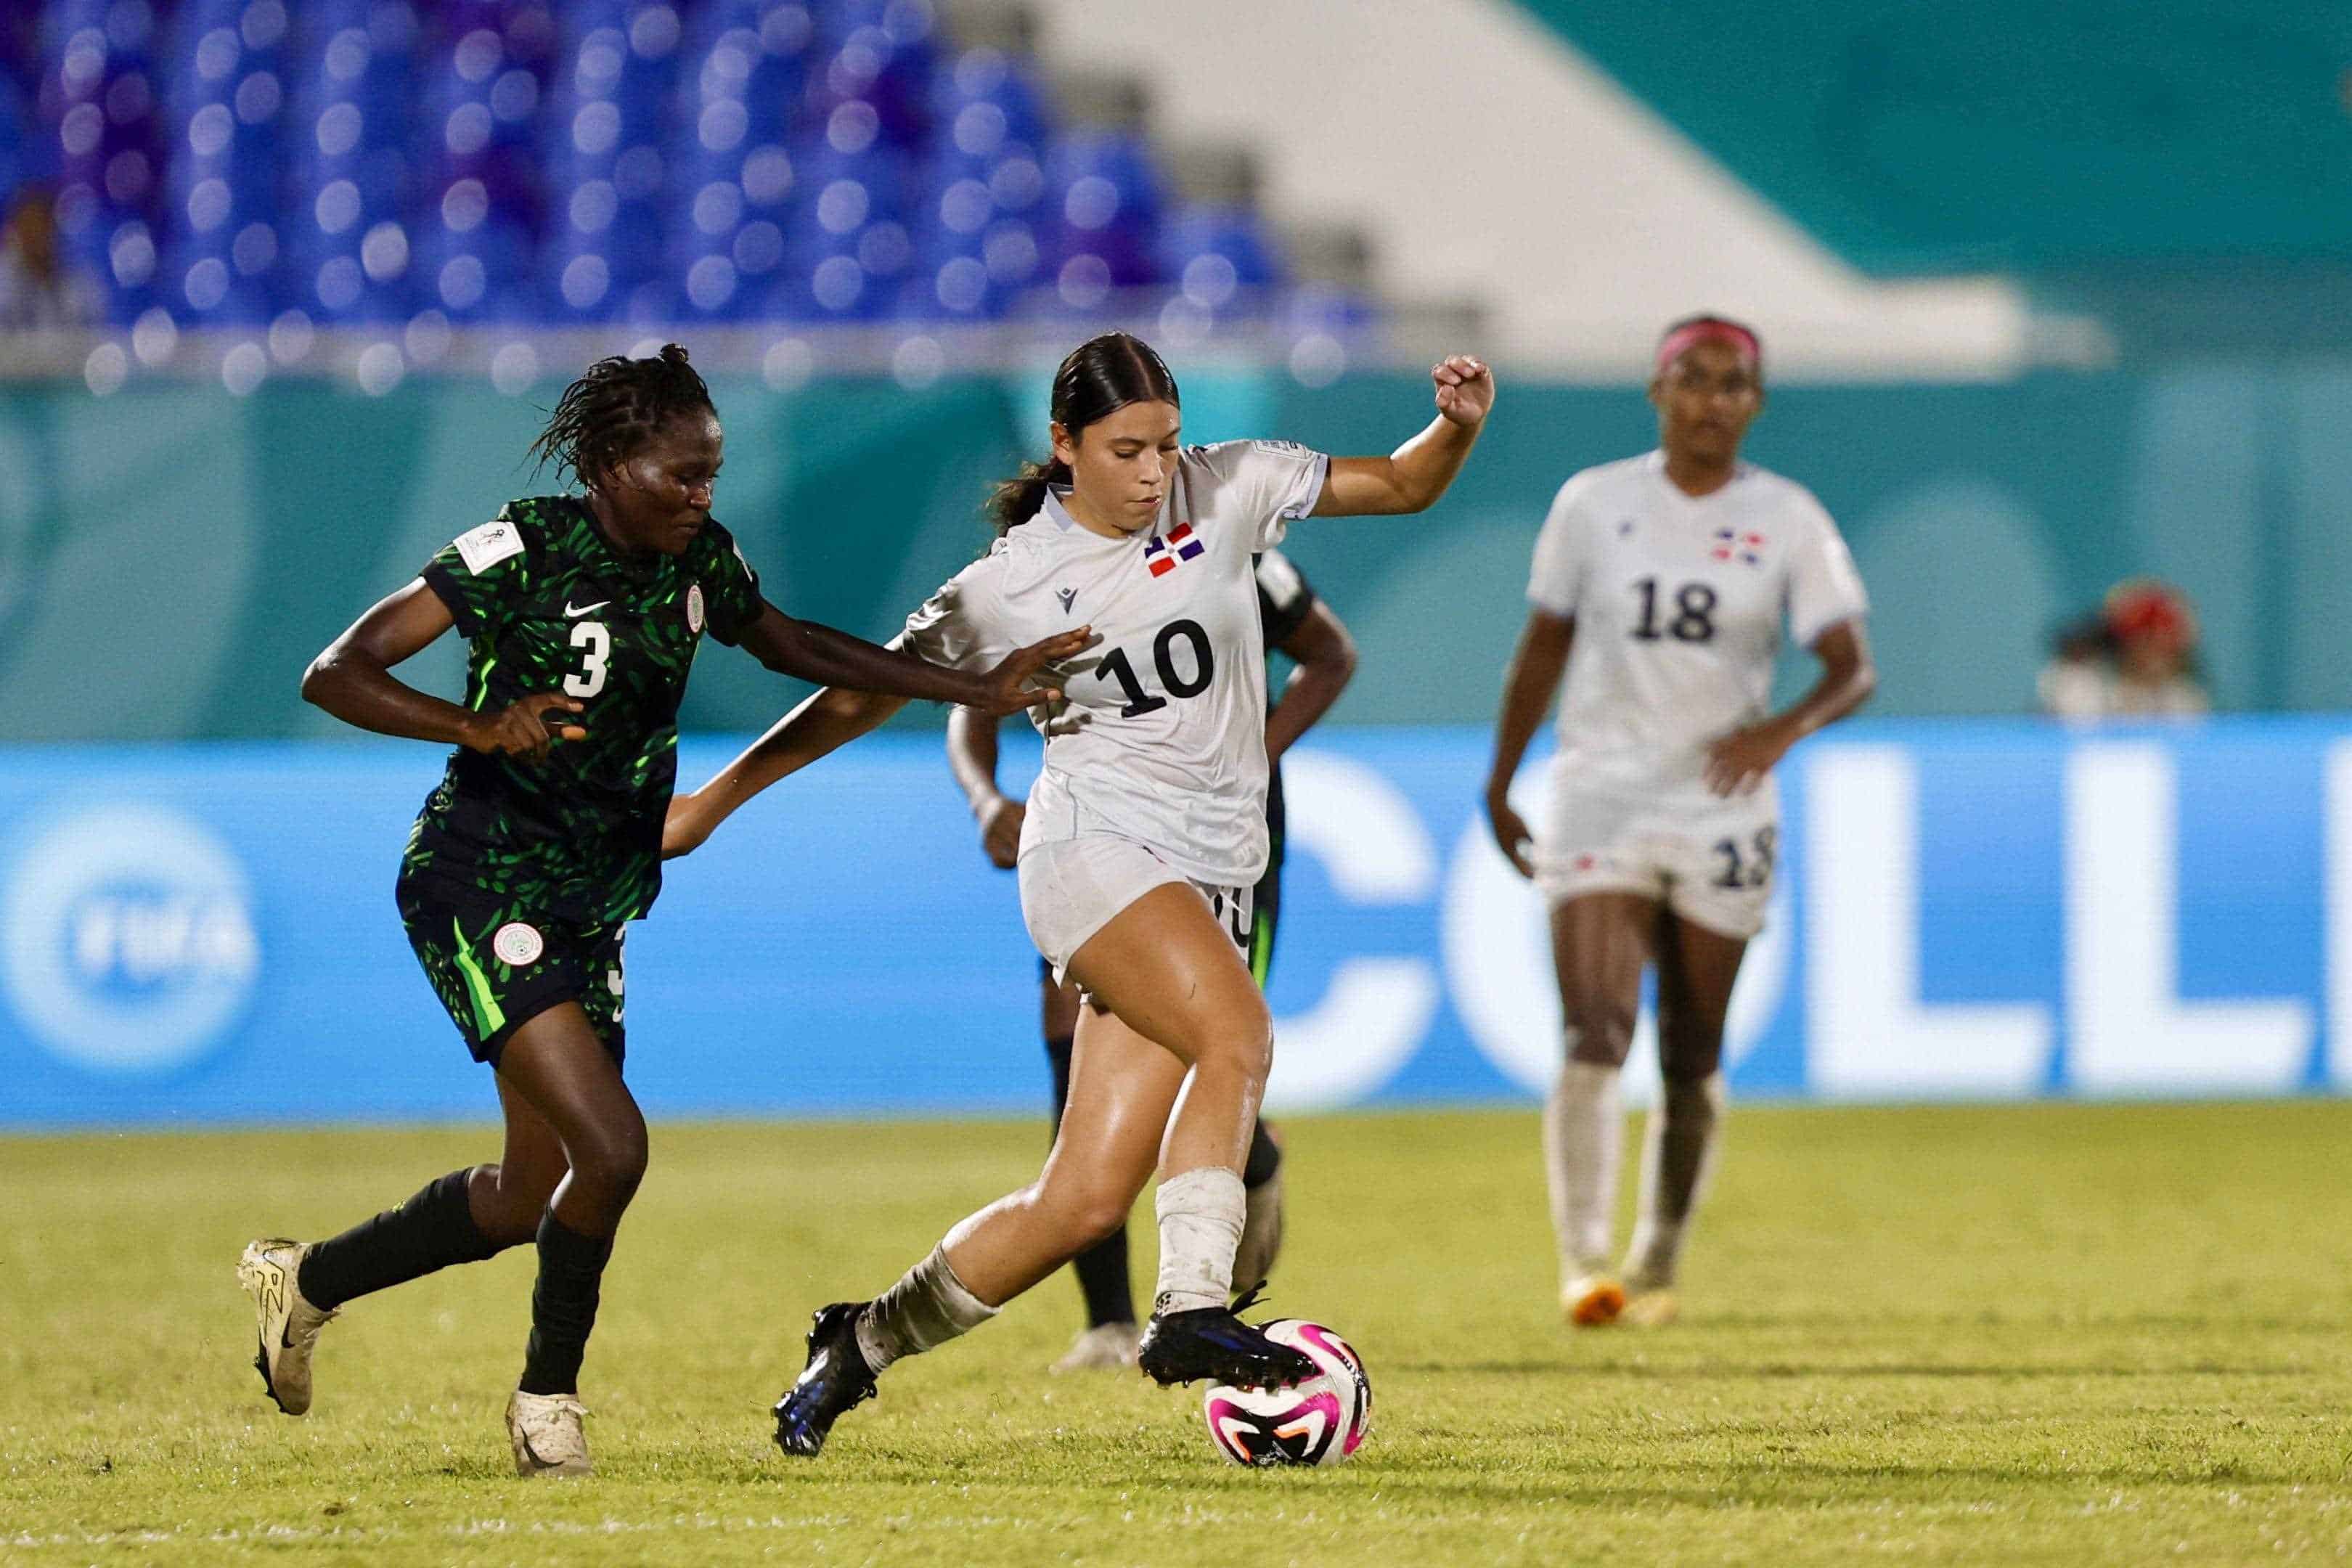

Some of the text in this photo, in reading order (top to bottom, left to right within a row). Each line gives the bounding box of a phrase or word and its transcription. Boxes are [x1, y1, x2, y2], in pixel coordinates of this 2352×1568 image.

[1630, 578, 1718, 643] 18
[563, 621, 610, 697] 3
[1095, 618, 1214, 718] 10
